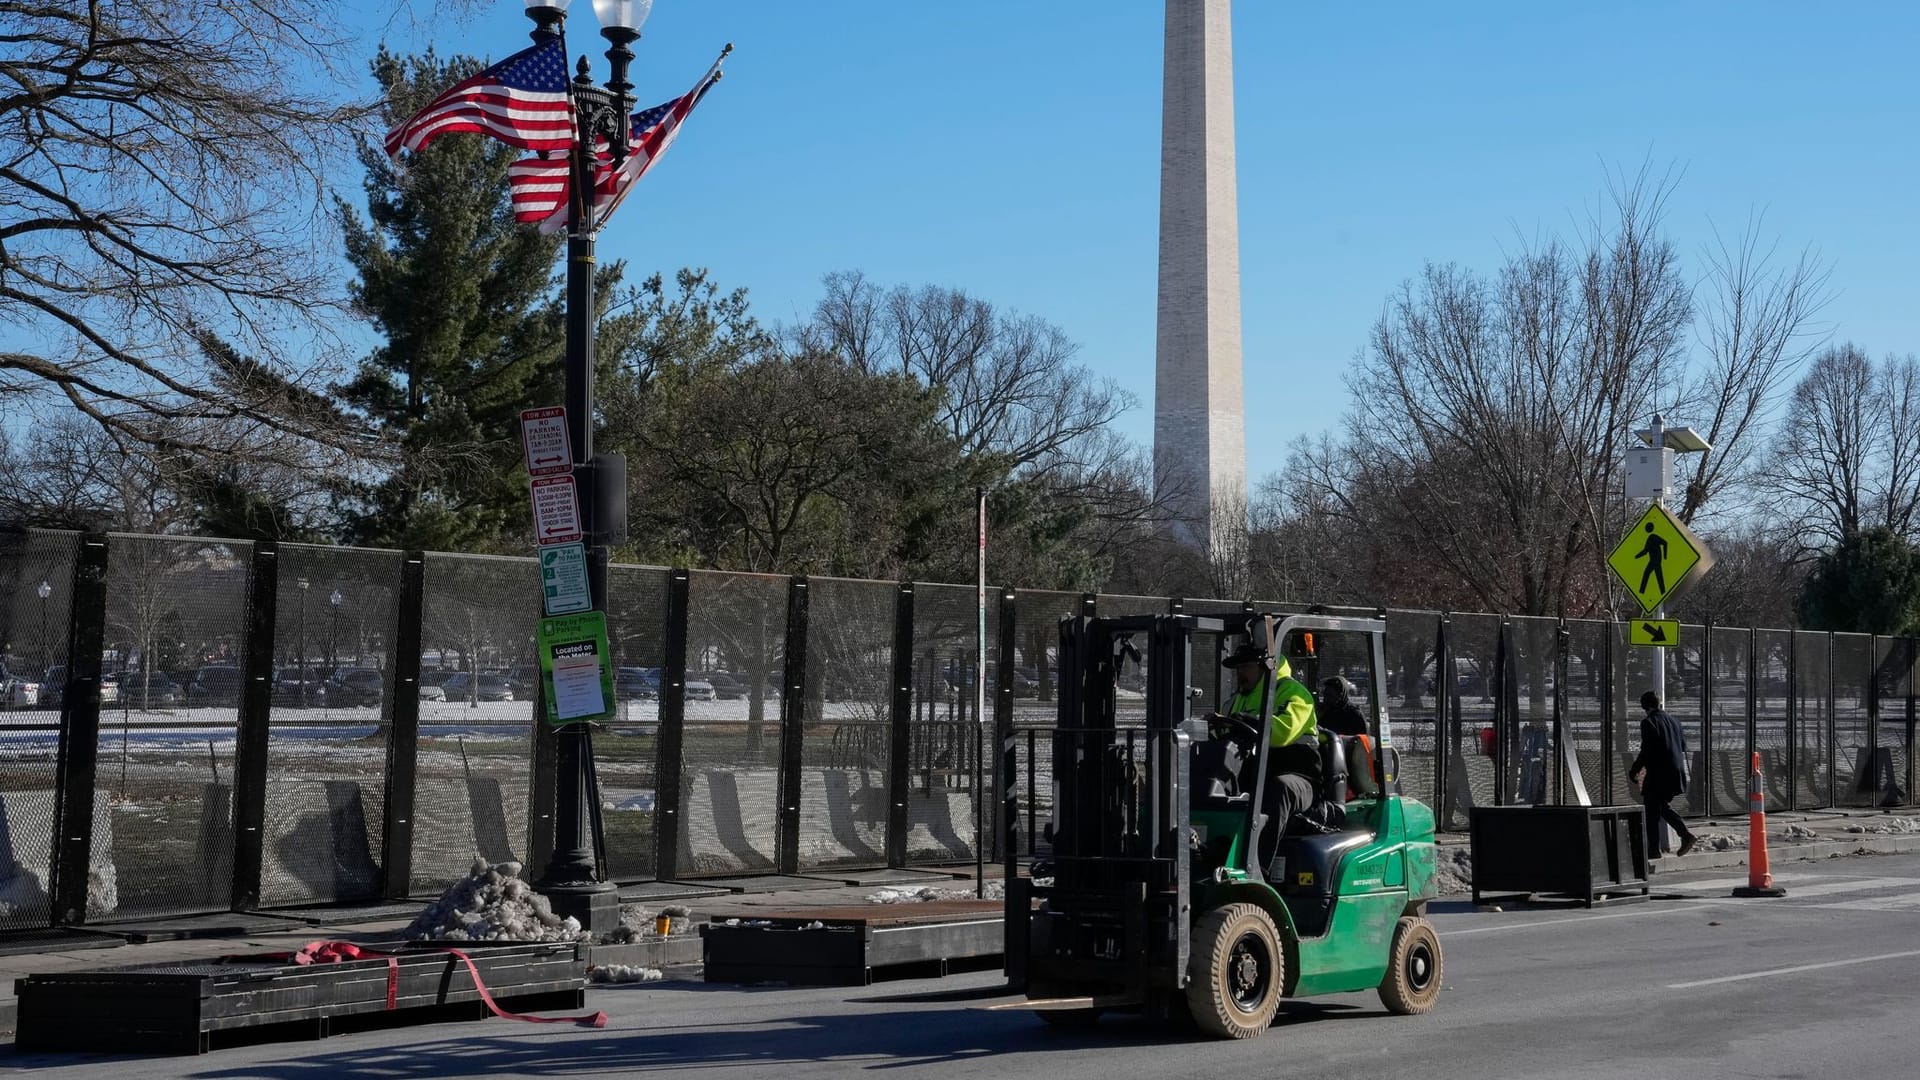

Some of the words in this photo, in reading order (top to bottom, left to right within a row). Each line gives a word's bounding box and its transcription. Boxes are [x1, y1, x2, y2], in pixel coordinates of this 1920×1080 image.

[527, 411, 539, 419] TOW
[542, 409, 560, 417] AWAY
[529, 425, 561, 434] PARKING
[537, 432, 562, 440] STANDING
[547, 485, 571, 493] PARKING
[555, 620, 567, 628] Pay
[556, 625, 581, 633] Parking
[555, 644, 582, 655] Located
